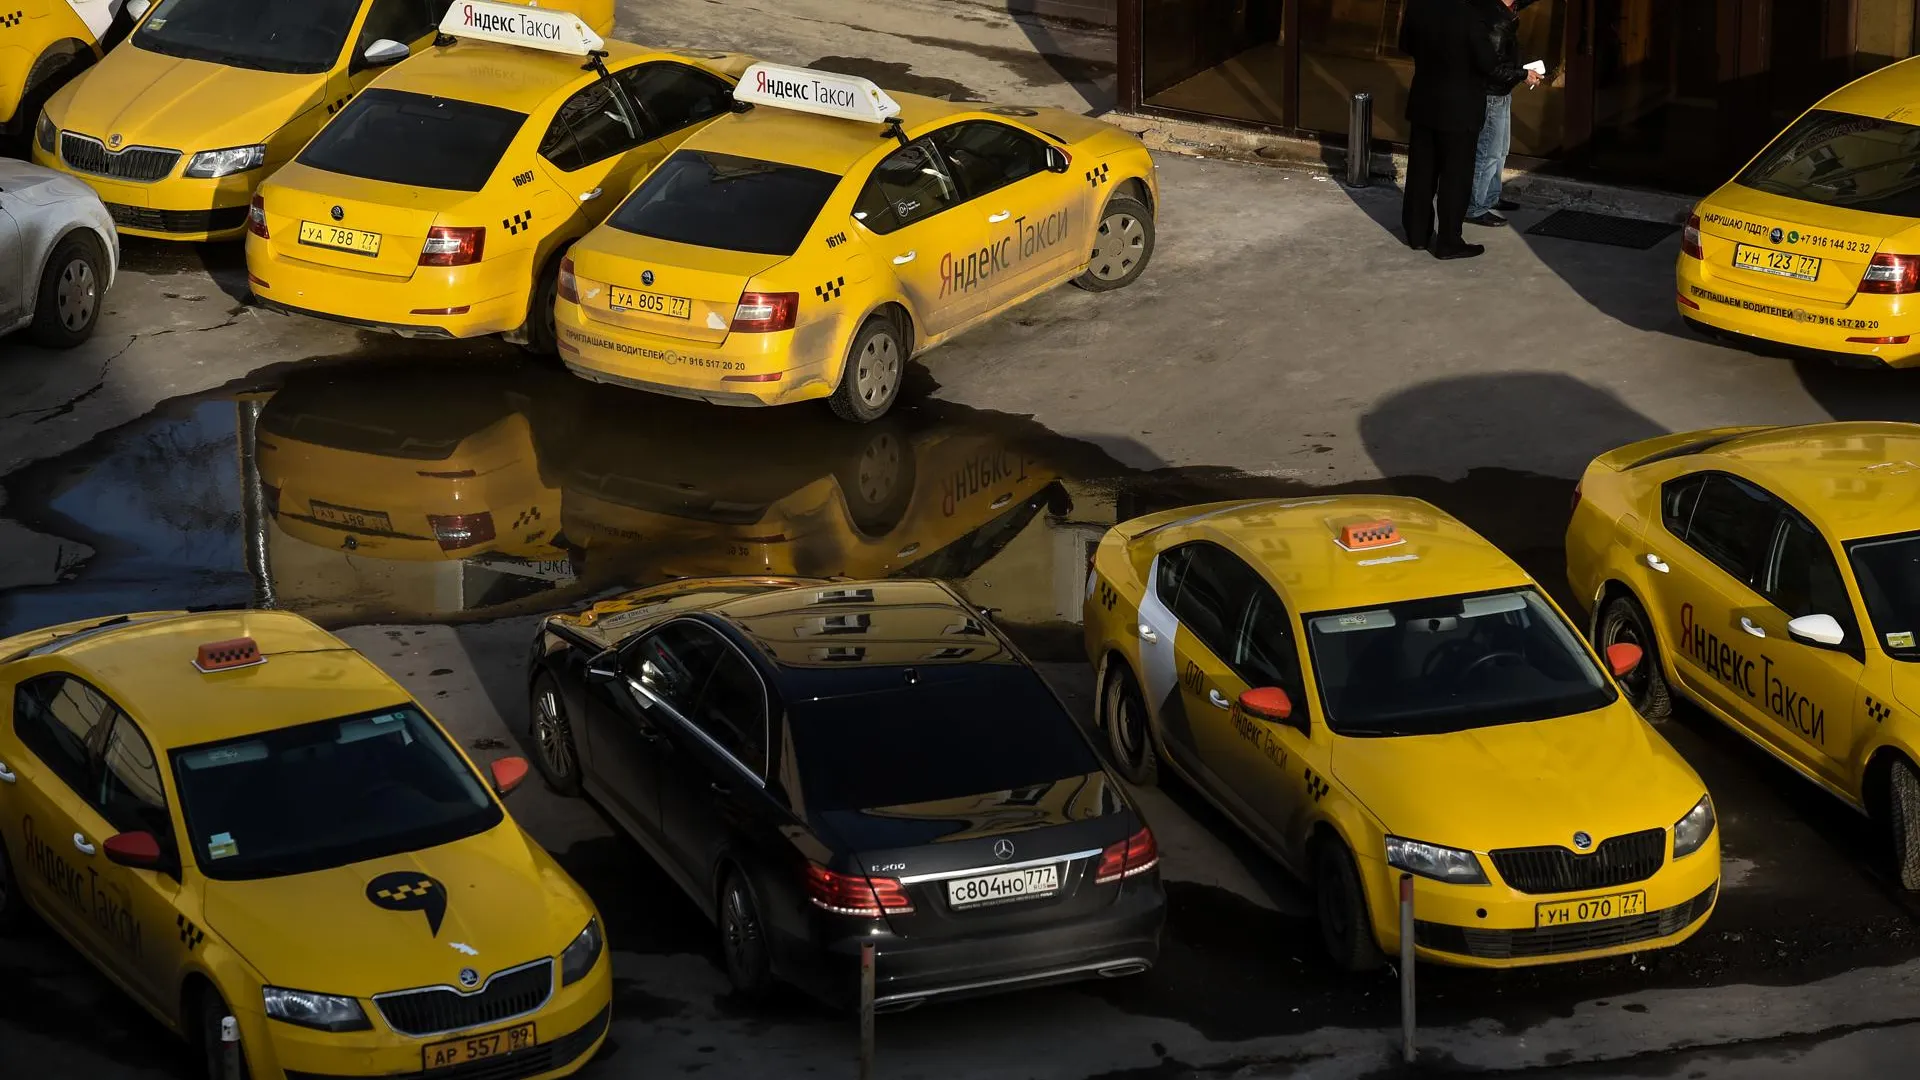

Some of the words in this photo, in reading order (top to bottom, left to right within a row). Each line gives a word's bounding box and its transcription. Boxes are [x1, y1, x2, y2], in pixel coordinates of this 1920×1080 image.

[463, 4, 515, 33] Яндекс
[519, 13, 561, 41] Такси
[756, 70, 809, 100] Яндекс
[812, 80, 855, 108] Такси
[512, 170, 534, 188] 16097
[308, 227, 322, 240] УА
[330, 228, 353, 246] 788
[362, 233, 375, 246] 77
[825, 231, 847, 249] 16114
[1704, 212, 1742, 230] НАРУШАЮ
[1744, 221, 1769, 237] ПДД?!
[1800, 235, 1810, 244] +7
[1812, 236, 1827, 247] 916
[1829, 238, 1844, 249] 144
[1846, 241, 1858, 252] 32
[1859, 243, 1871, 254] 32
[938, 235, 1011, 300] Яндекс
[1015, 207, 1068, 261] Такси
[1743, 250, 1759, 264] УН
[1767, 252, 1793, 270] 123
[1799, 256, 1813, 270] 77
[618, 292, 633, 307] УА
[638, 293, 664, 311] 805
[672, 298, 685, 311] 77
[1690, 285, 1741, 308] ПРИГЛАШАЕМ
[1743, 301, 1793, 319] ВОДИТЕЛЕЙ
[1807, 314, 1817, 324] +7
[1819, 316, 1835, 326] 916
[1837, 318, 1852, 329] 517
[1855, 319, 1866, 329] 20
[1868, 320, 1879, 329] 20
[566, 329, 615, 350] ПРИГЛАШАЕМ
[616, 343, 665, 361] ВОДИТЕЛЕЙ
[677, 356, 687, 364] +7
[689, 357, 704, 367] 916
[706, 358, 720, 369] 517
[722, 360, 733, 370] 20
[735, 362, 746, 371] 20
[1185, 660, 1204, 695] 070
[1680, 601, 1756, 698] Яндекс
[1760, 653, 1825, 746] Такси
[1231, 701, 1262, 750] Яндекс
[1264, 728, 1288, 771] Такси
[882, 863, 906, 872] 200
[1026, 868, 1051, 885] 777
[23, 813, 88, 914] Яндекс
[87, 865, 144, 959] Такси
[1033, 883, 1047, 891] RUS
[1548, 908, 1570, 924] УН
[1578, 899, 1611, 920] 070
[1622, 894, 1638, 909] 77
[435, 1048, 457, 1066] АР
[466, 1034, 500, 1059] 557
[511, 1028, 528, 1044] 99
